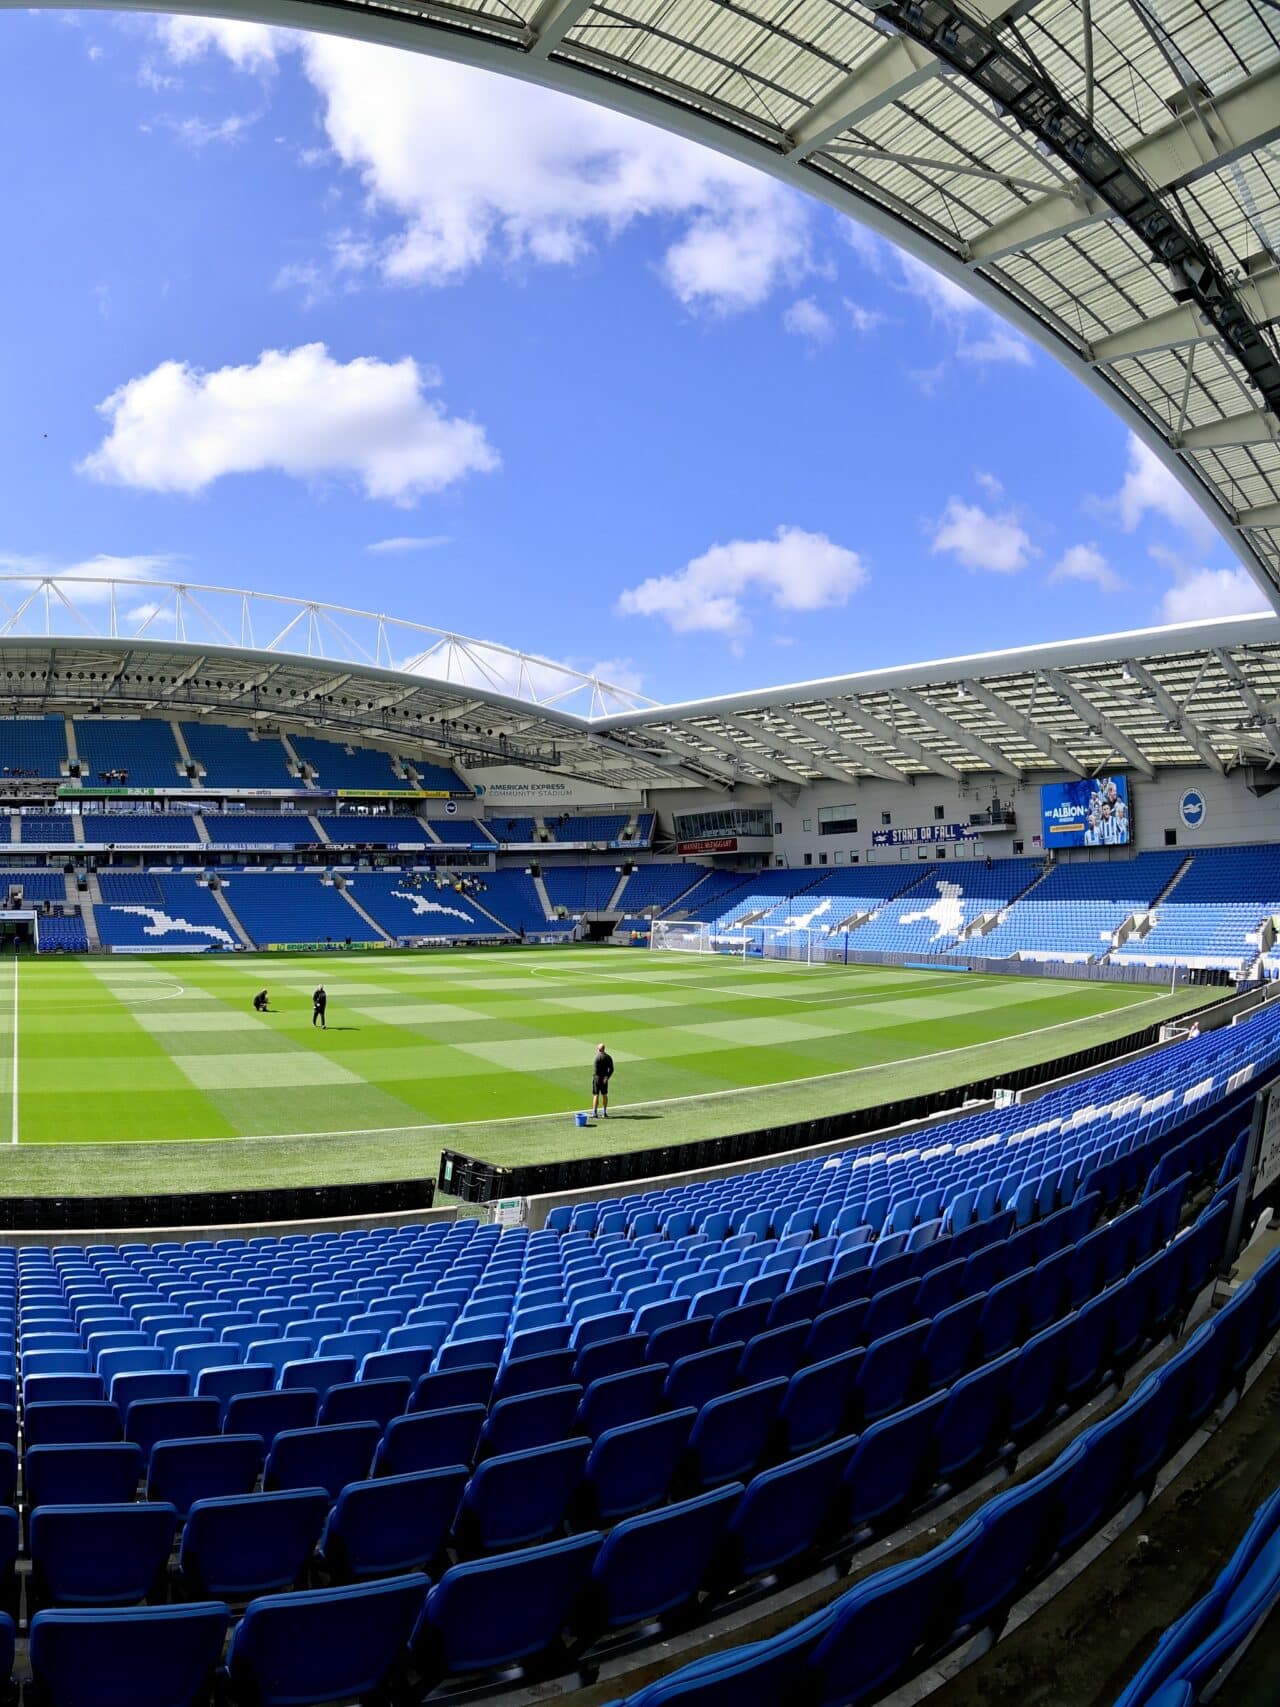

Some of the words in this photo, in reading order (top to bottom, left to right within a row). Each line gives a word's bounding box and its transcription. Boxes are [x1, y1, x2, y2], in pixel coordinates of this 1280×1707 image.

[489, 790, 534, 798] COMMUNITY
[892, 829, 918, 842] STAND
[921, 828, 932, 840] OR
[934, 825, 956, 839] FALL
